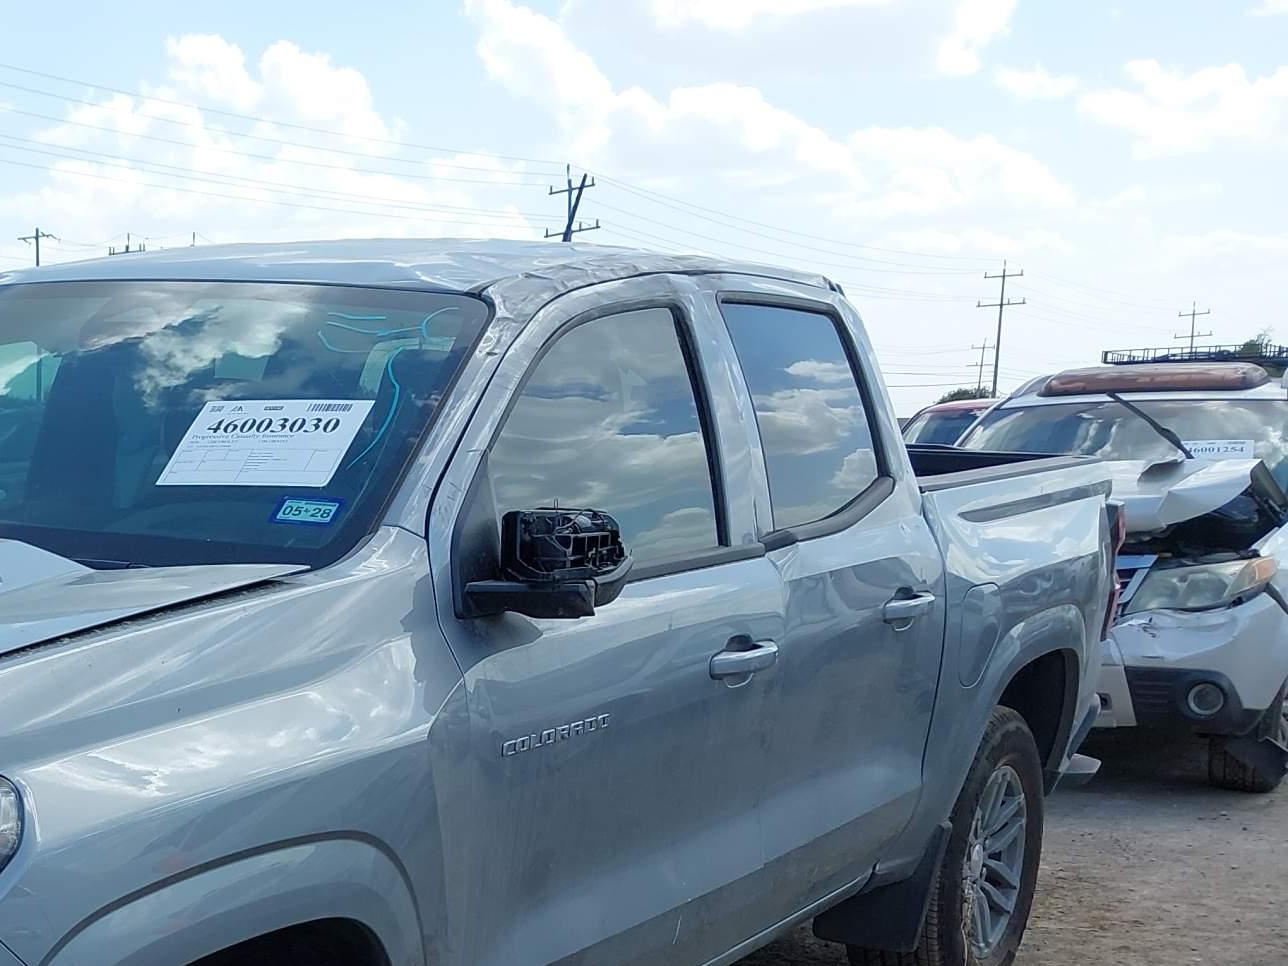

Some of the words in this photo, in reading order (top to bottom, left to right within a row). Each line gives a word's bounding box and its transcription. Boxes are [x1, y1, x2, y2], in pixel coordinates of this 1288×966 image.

[206, 417, 341, 434] 46003030
[282, 505, 304, 517] 05
[310, 507, 333, 519] 28
[501, 713, 611, 757] COLORADO
